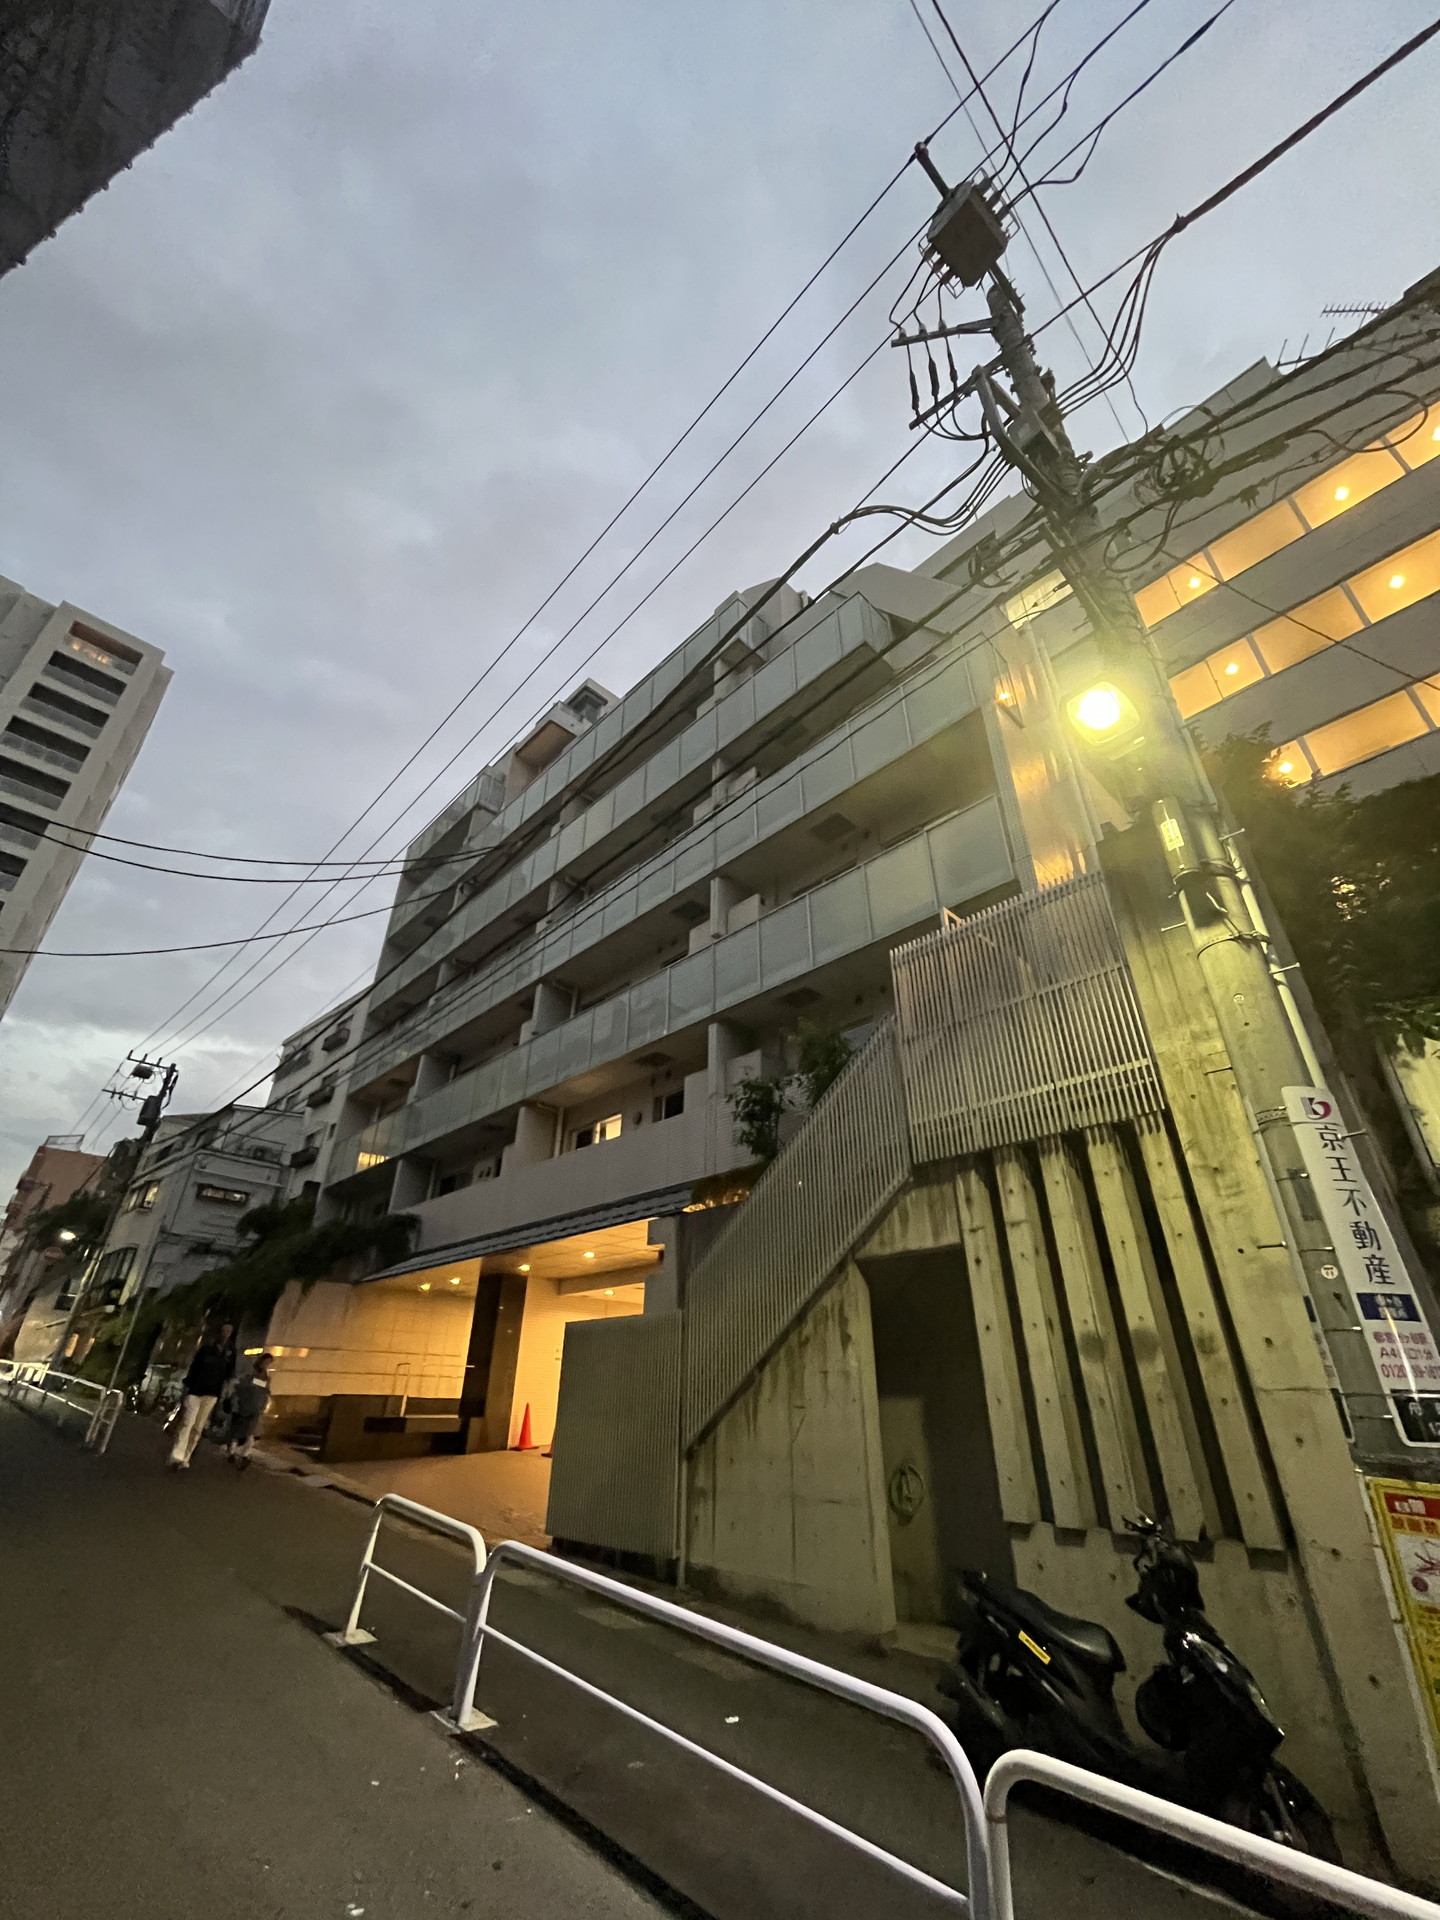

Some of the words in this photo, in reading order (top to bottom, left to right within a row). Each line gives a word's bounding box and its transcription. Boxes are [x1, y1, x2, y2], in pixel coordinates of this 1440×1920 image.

[1314, 1125, 1396, 1286] 京王不動産
